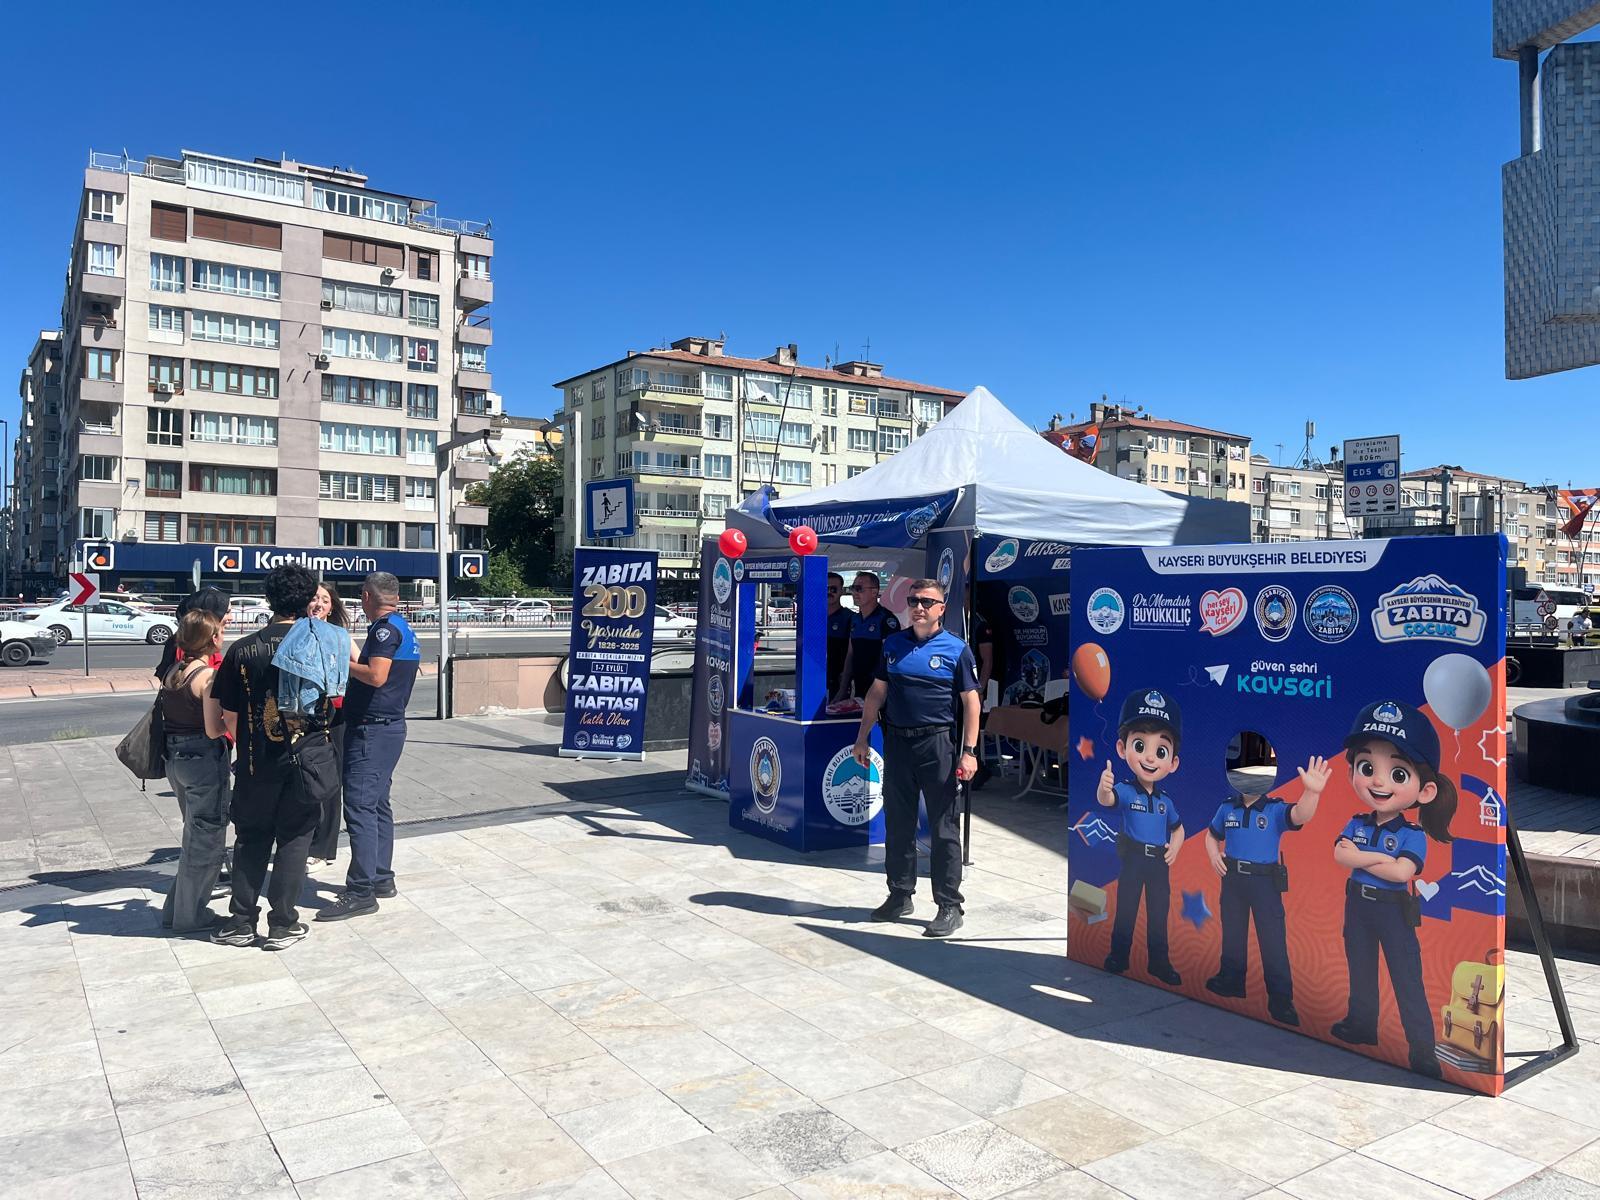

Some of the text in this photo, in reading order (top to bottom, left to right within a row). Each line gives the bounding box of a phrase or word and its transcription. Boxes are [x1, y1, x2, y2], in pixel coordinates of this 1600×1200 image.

[1352, 468, 1372, 477] EDS
[1158, 551, 1367, 569] KAYSERİ BÜYÜKŞEHİR BELEDİYESİ
[580, 561, 652, 587] ZABITA
[581, 584, 647, 619] 200
[1148, 594, 1192, 607] Memduh
[1205, 602, 1237, 618] Kayseri
[1391, 606, 1468, 625] ZABITA
[1318, 626, 1344, 635] ZABITA
[1403, 622, 1457, 638] ÇOCUK
[606, 662, 624, 673] EYLÜL
[1250, 660, 1318, 675] güven şehri
[571, 674, 645, 694] ZABITA
[1237, 674, 1332, 698] kayseri
[574, 695, 639, 712] HAFTASI
[606, 712, 631, 726] Olsun
[1138, 706, 1170, 721] ZABITA
[1362, 722, 1407, 740] ZABITA
[1131, 803, 1146, 812] ZABITA
[847, 815, 864, 823] 1869
